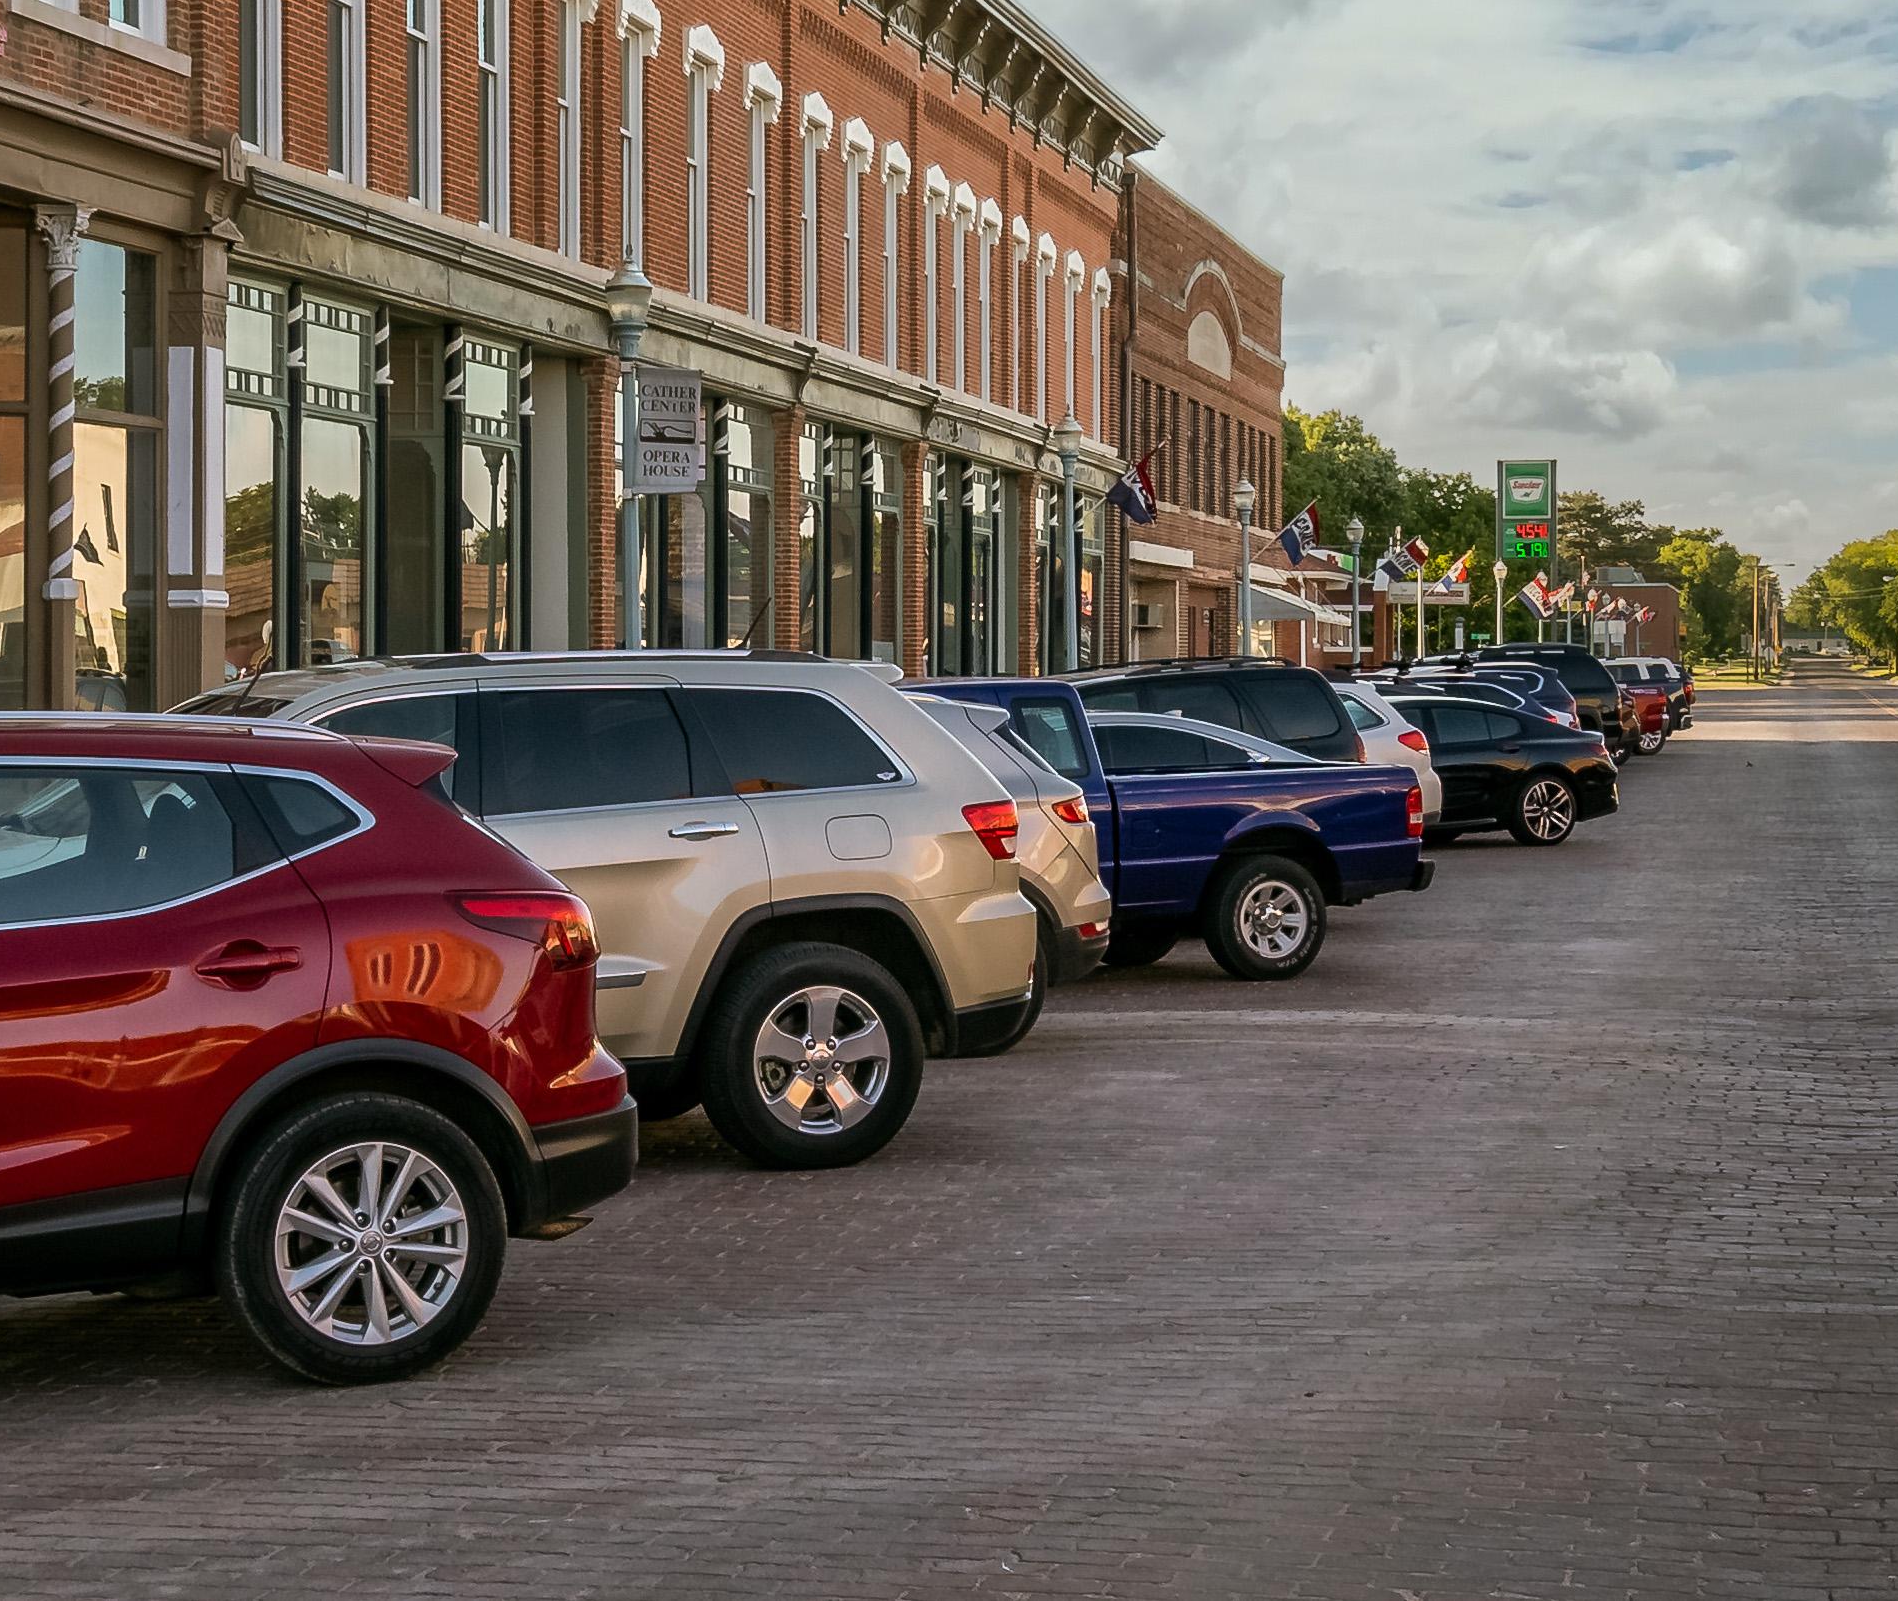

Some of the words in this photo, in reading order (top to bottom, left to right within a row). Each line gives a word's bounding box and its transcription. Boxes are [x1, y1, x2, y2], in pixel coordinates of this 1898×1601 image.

[641, 384, 697, 399] CATHER
[641, 400, 696, 414] CENTER
[643, 449, 690, 464] OPERA
[642, 464, 690, 478] HOUSE
